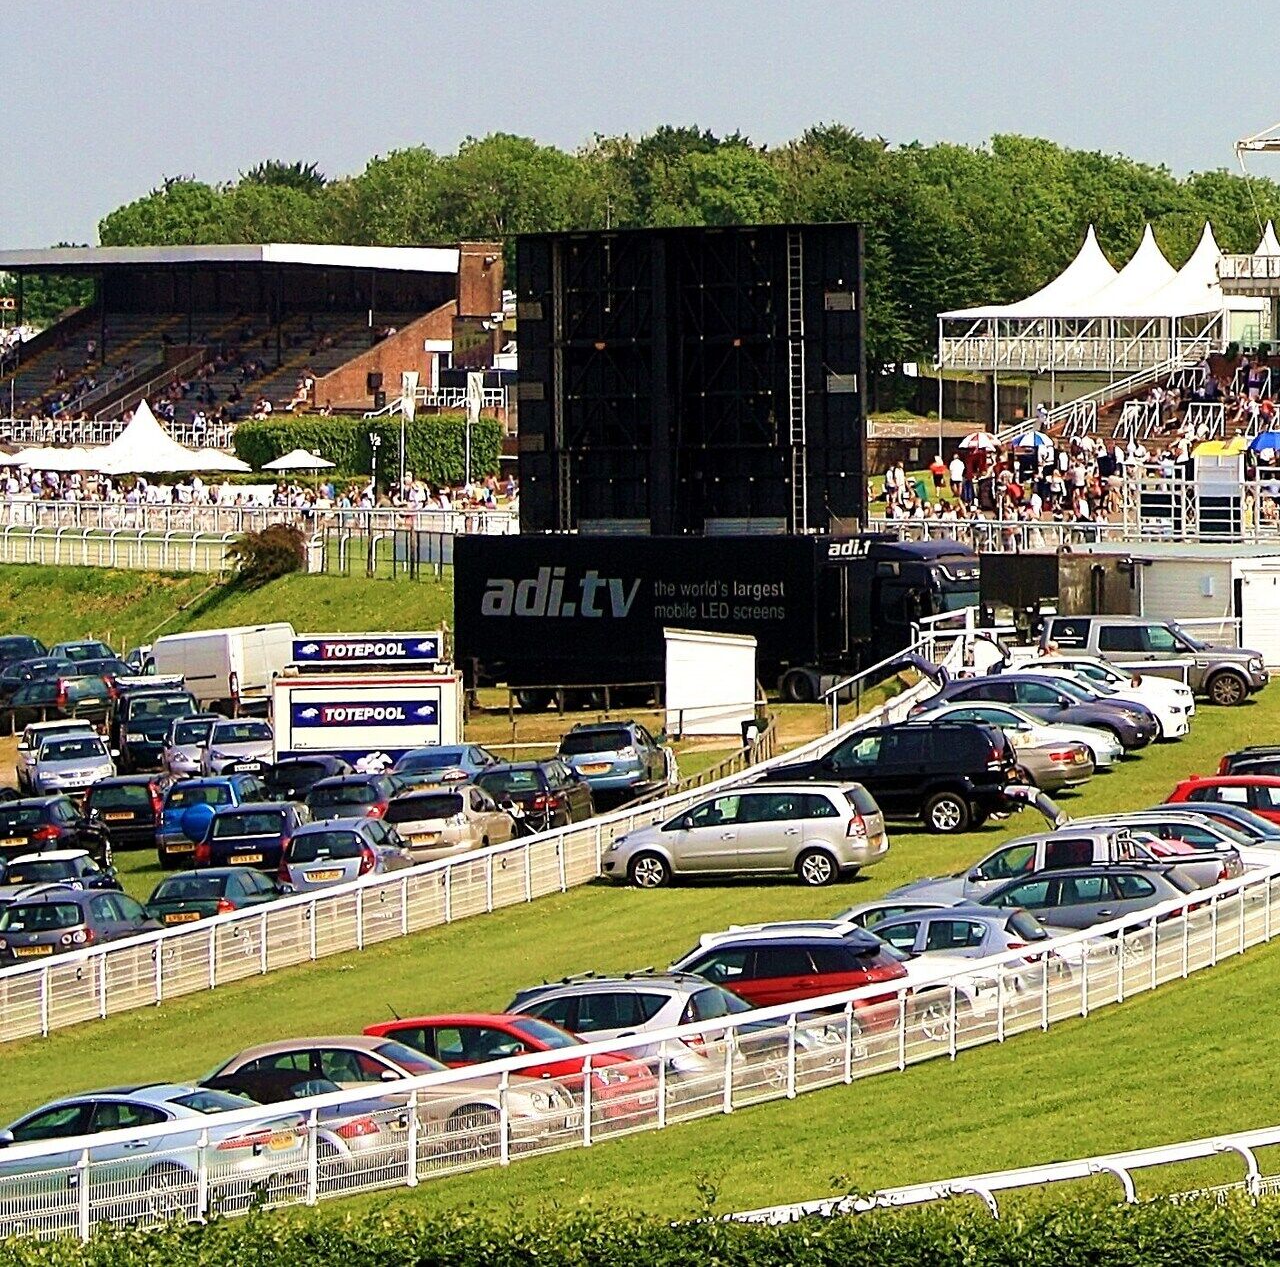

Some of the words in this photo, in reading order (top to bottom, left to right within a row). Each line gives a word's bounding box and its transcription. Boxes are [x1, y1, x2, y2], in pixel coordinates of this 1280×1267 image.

[481, 566, 642, 618] adi.tv
[654, 580, 678, 597] the
[680, 580, 729, 597] world's
[733, 580, 785, 600] largest
[654, 602, 698, 620] mobile
[701, 603, 729, 619] LED
[732, 605, 786, 620] screens
[325, 642, 406, 658] TOTEPOOL
[325, 706, 406, 722] TOTEPOOL
